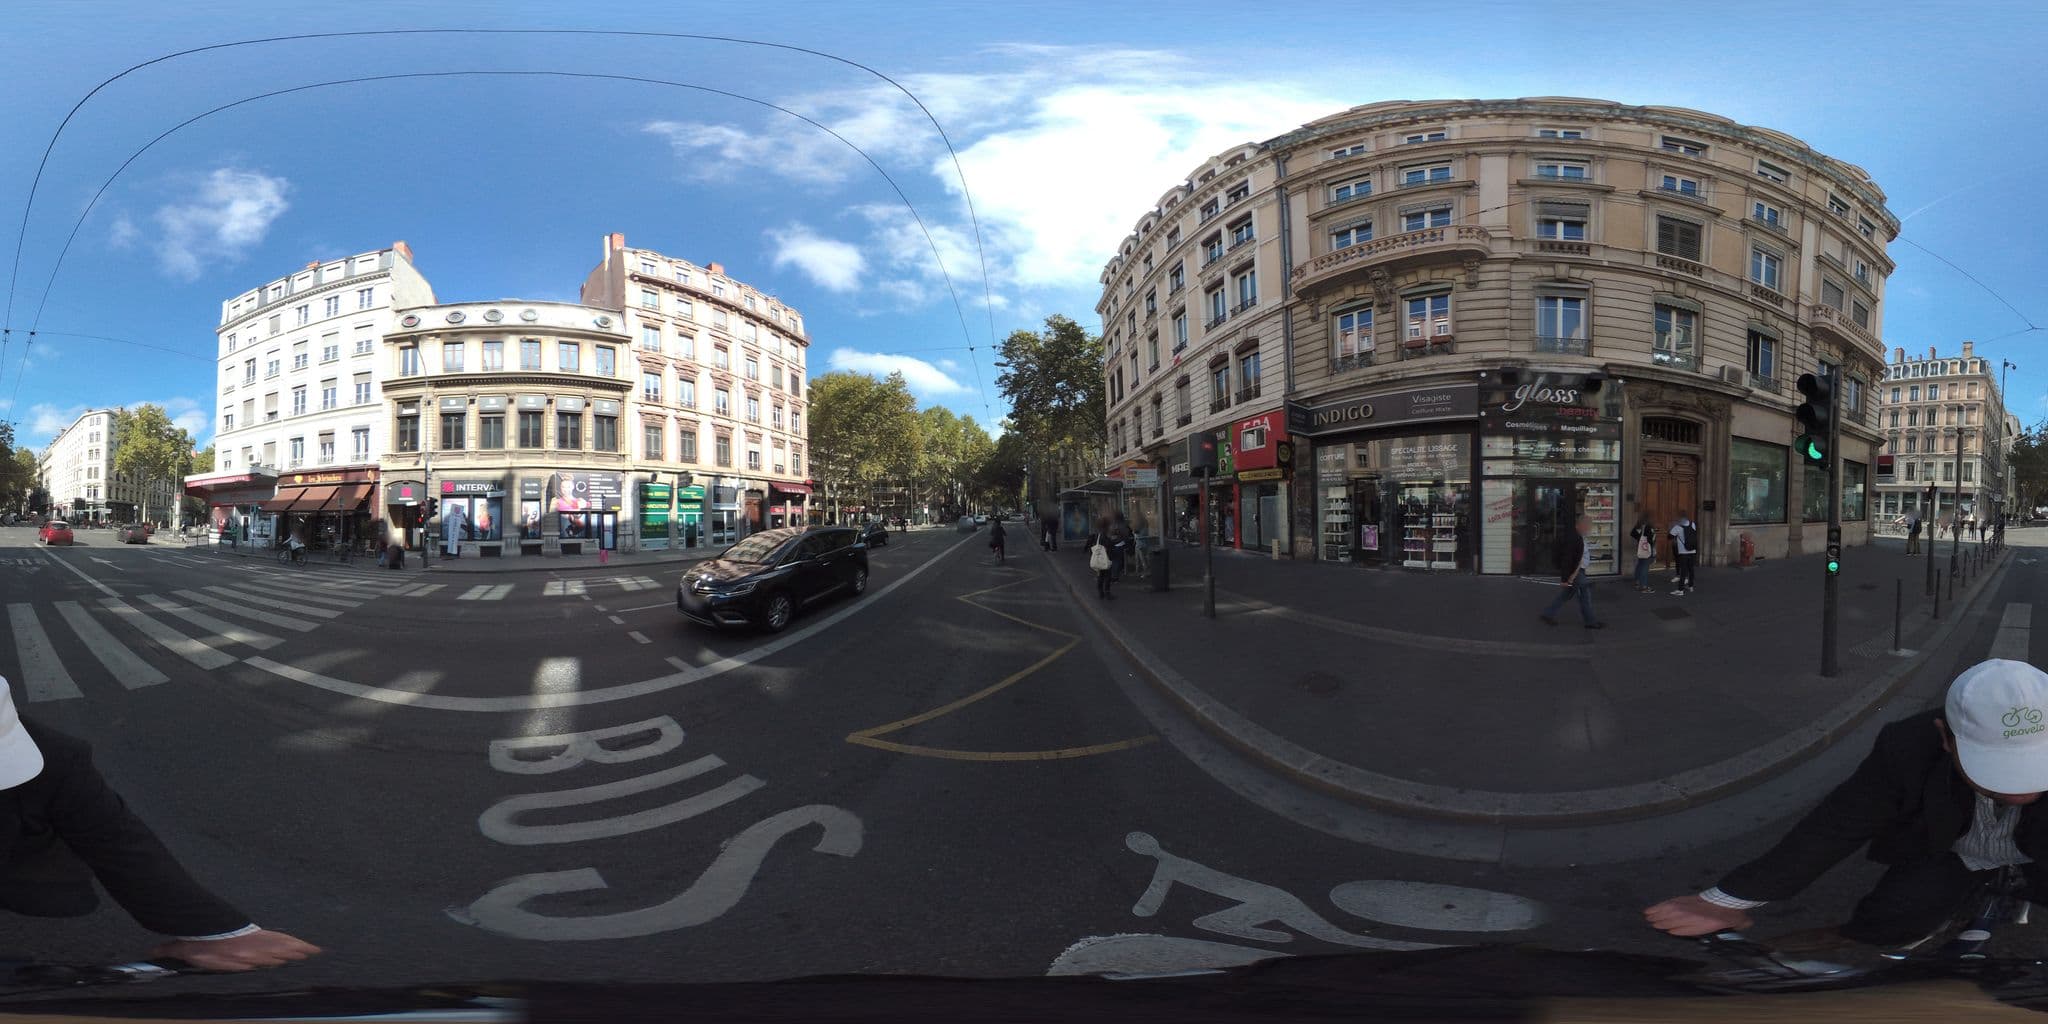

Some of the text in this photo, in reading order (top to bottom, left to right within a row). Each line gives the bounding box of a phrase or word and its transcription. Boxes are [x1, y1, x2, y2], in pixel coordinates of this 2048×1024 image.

[1502, 376, 1578, 411] gloss
[1313, 403, 1374, 426] INDIGO
[1560, 424, 1598, 433] Maquillage
[450, 715, 864, 941] BUS
